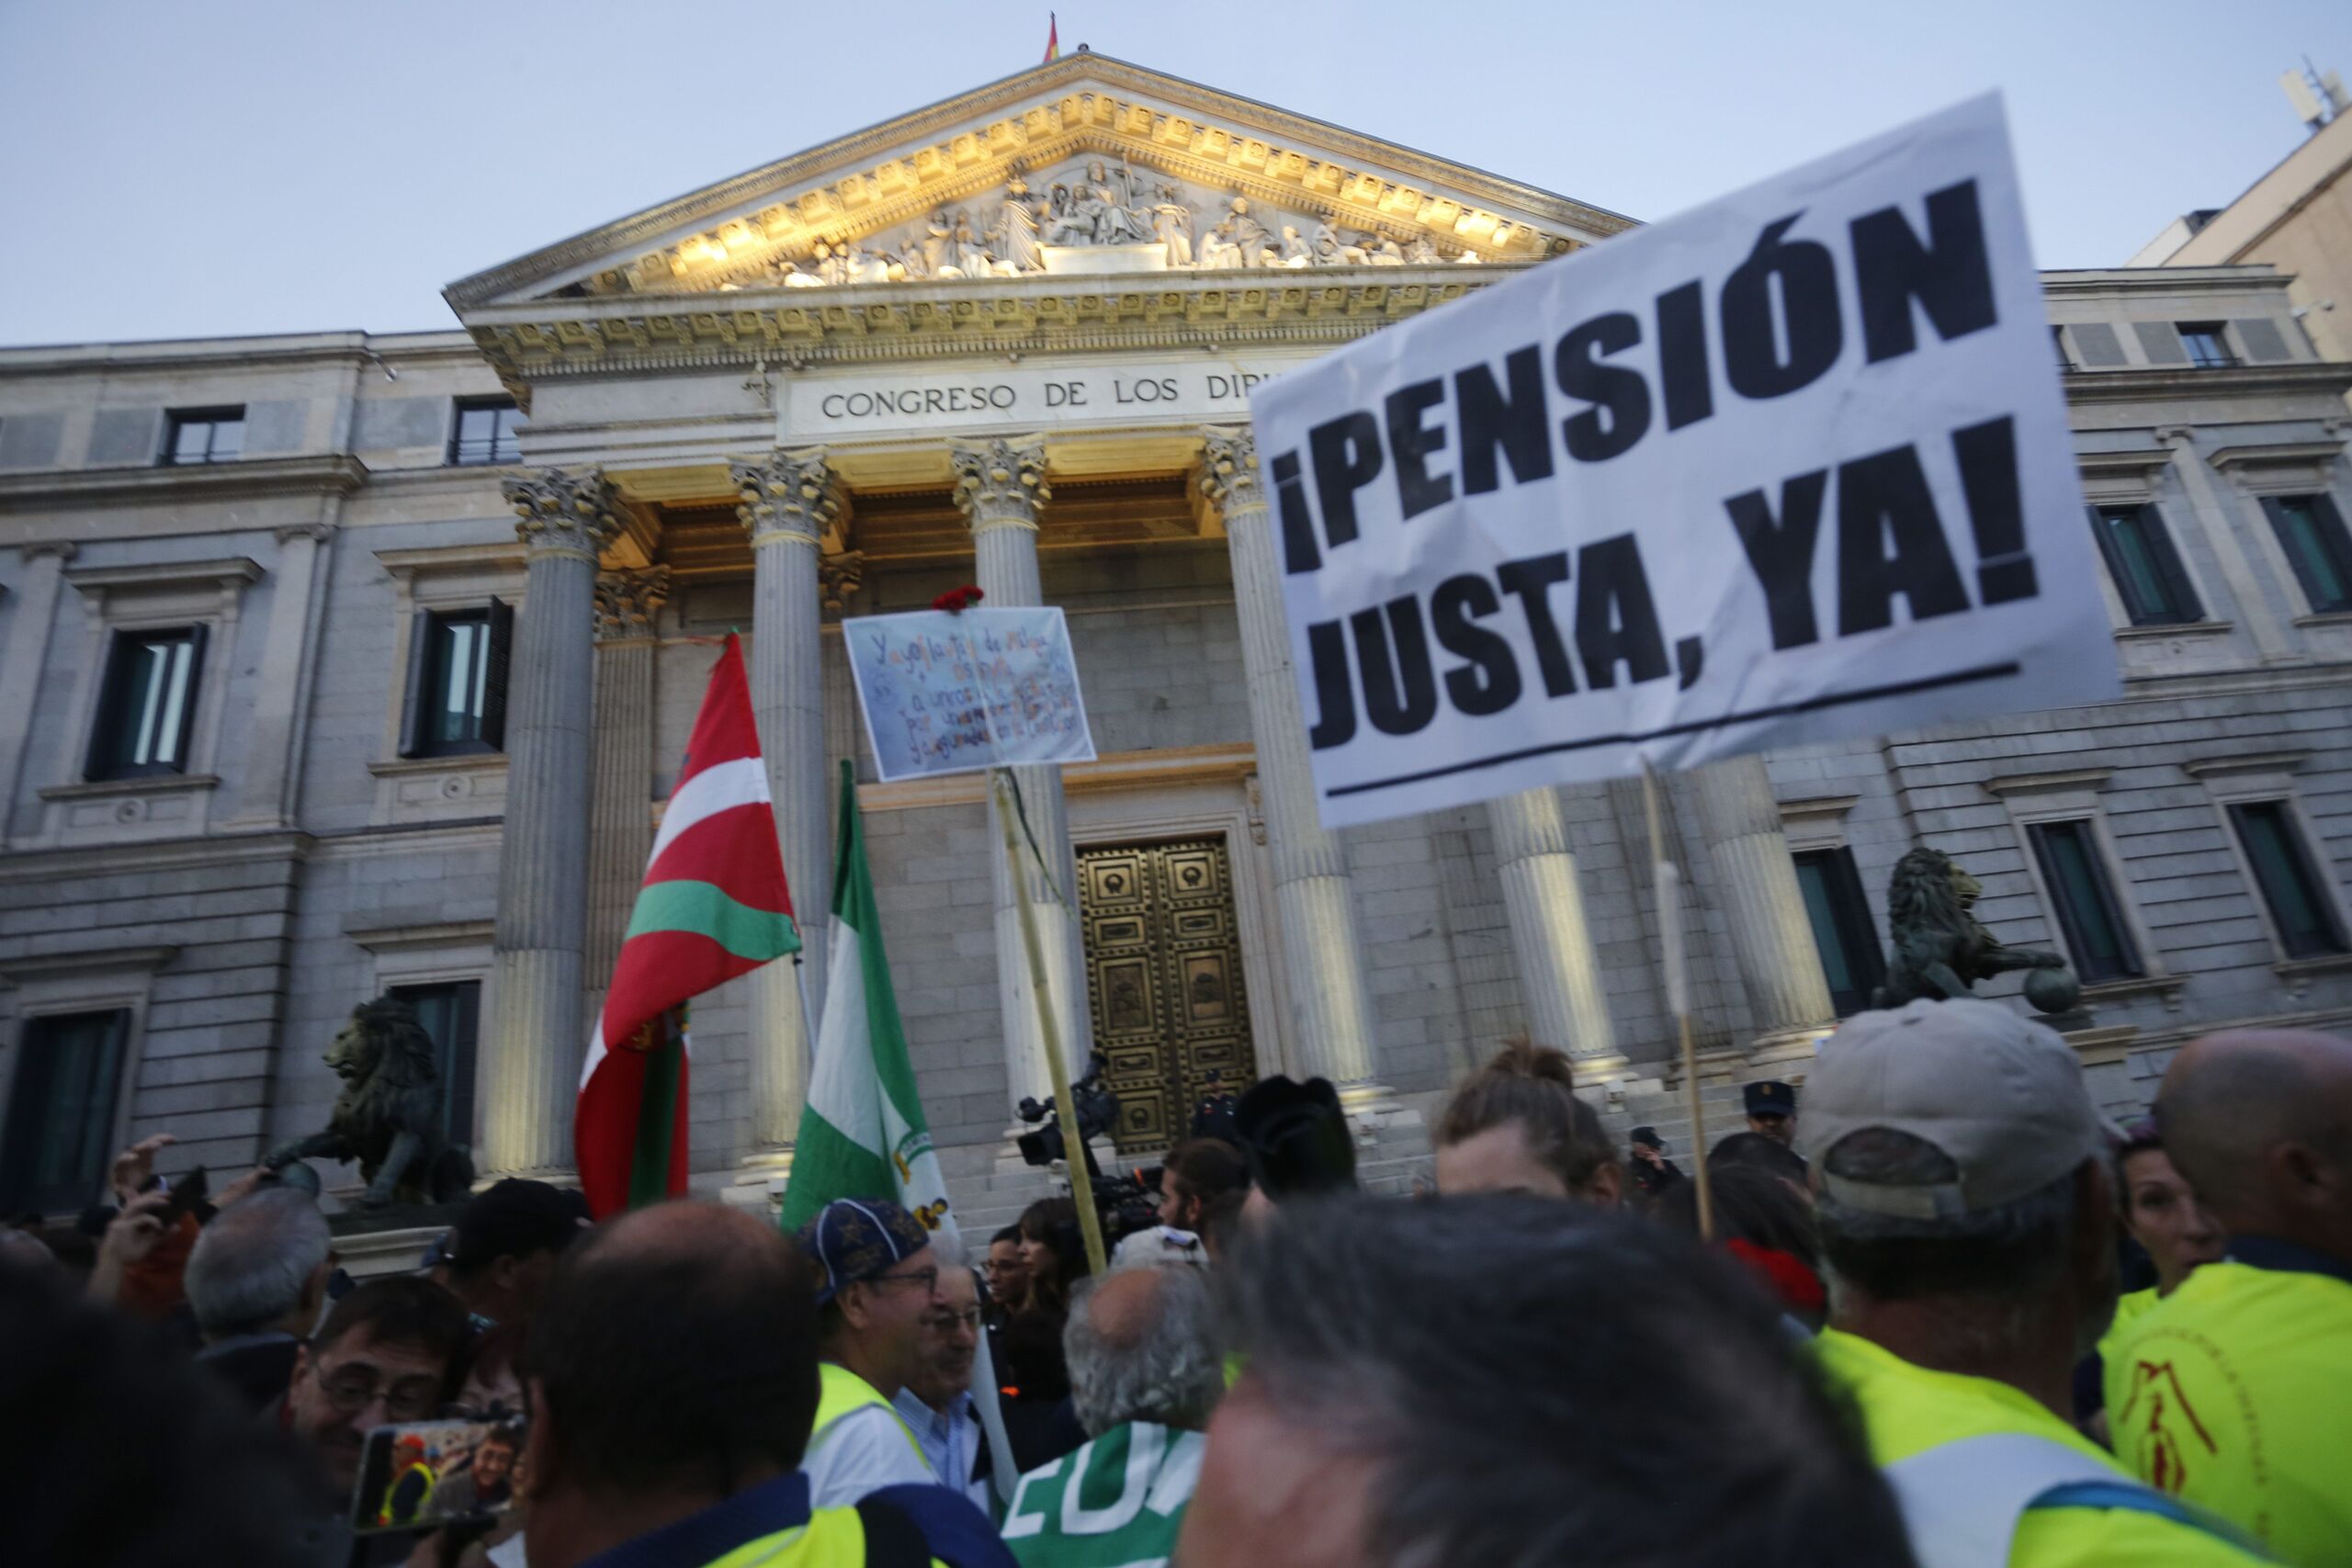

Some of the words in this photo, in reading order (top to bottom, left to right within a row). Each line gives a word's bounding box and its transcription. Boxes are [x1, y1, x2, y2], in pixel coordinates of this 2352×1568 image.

[821, 384, 1016, 420] CONGRESO
[1045, 381, 1088, 407] DE
[1114, 378, 1178, 404] LOS
[1206, 373, 1281, 399] DIP
[1271, 178, 1999, 575] ¡PENSIÓN
[1306, 531, 1704, 751] JUSTA,
[1724, 413, 2040, 652] YA!
